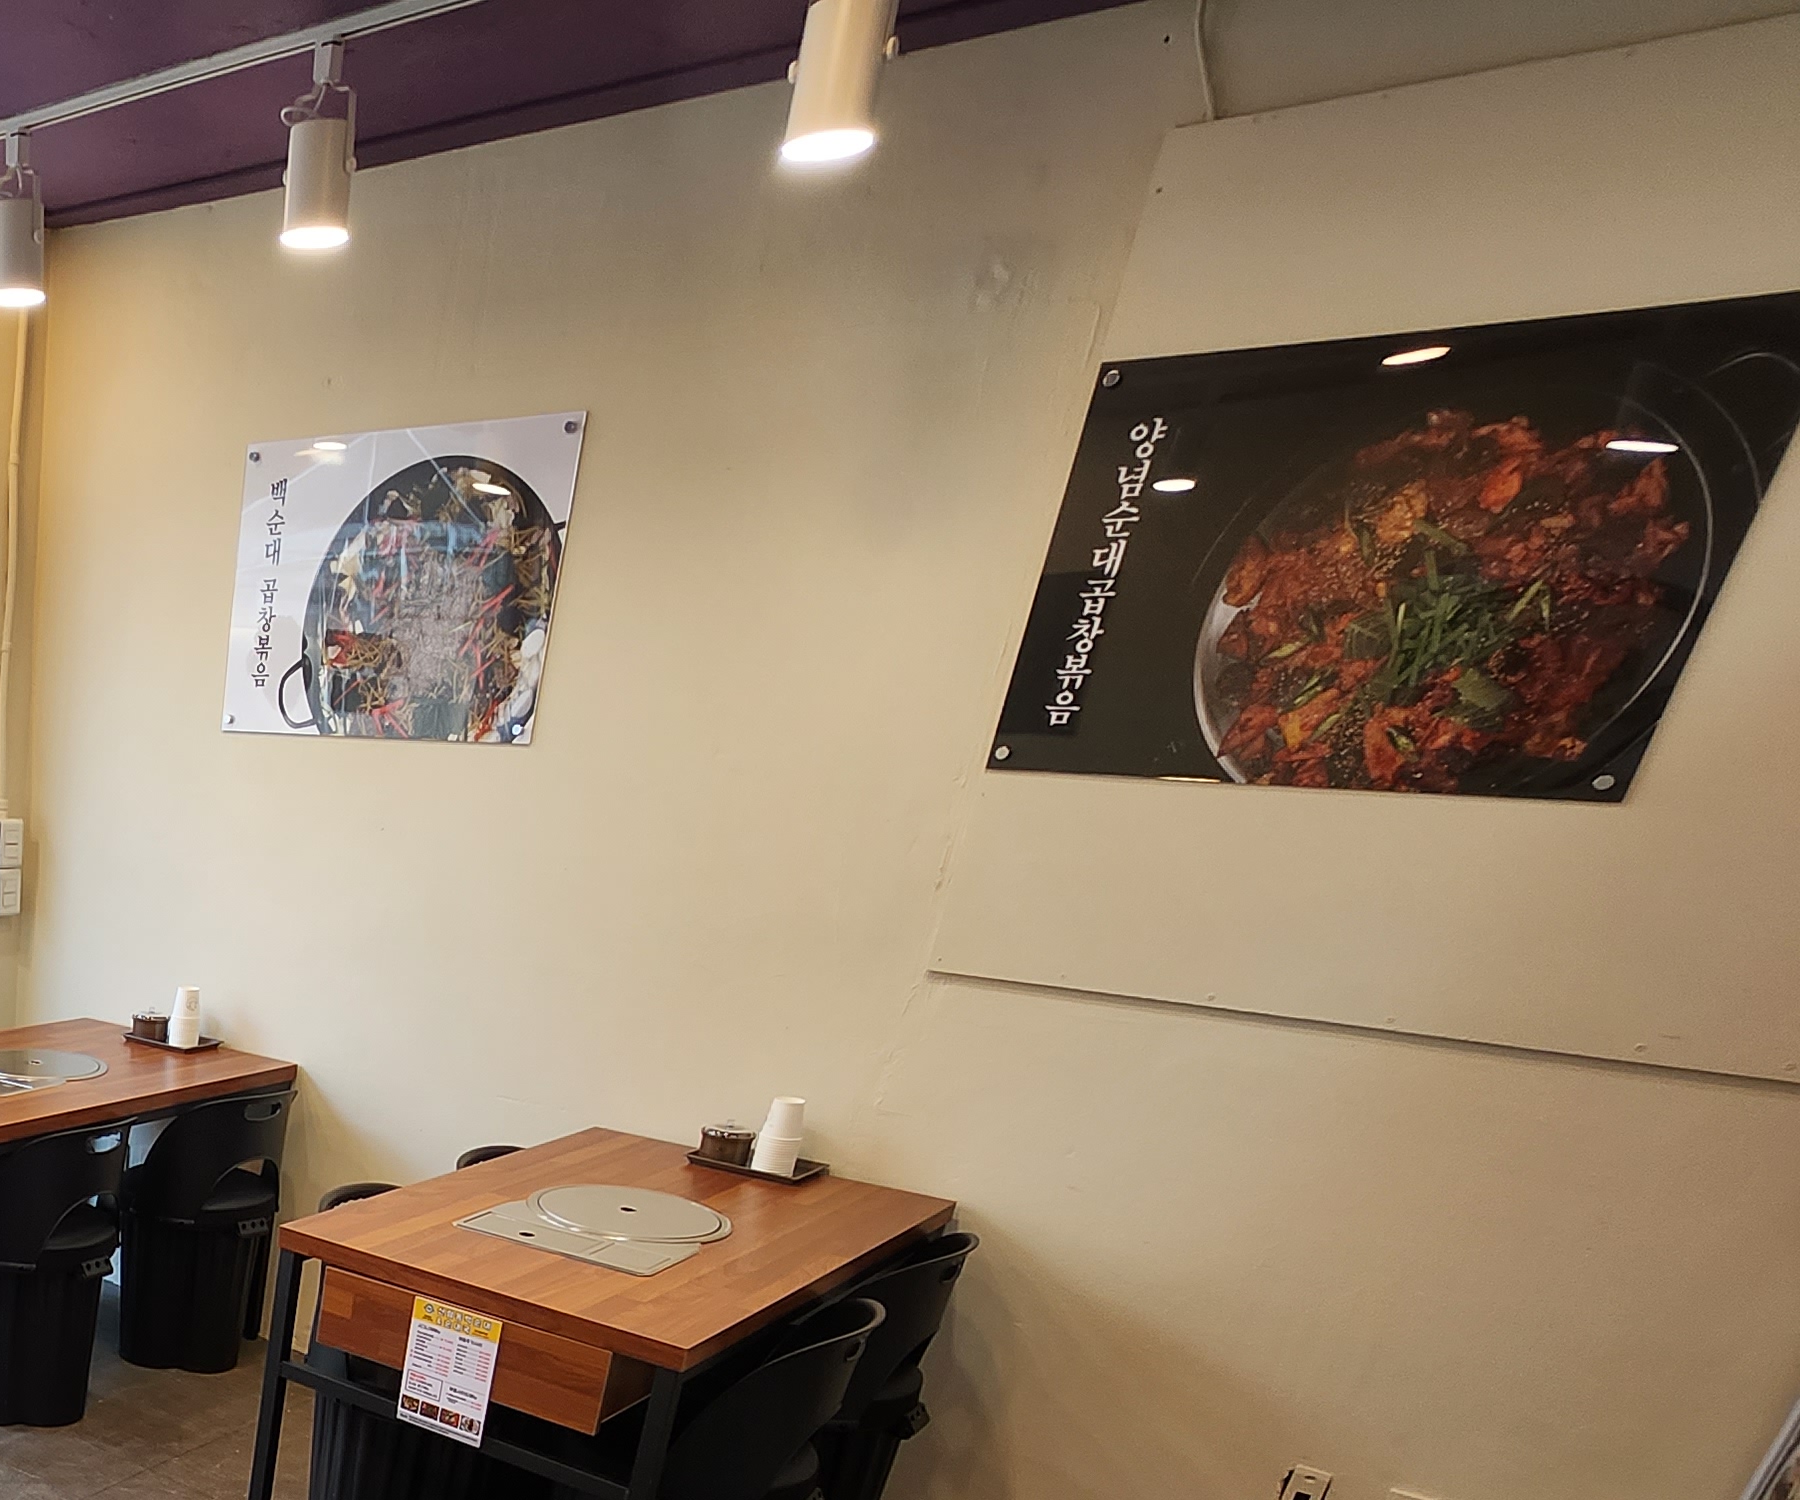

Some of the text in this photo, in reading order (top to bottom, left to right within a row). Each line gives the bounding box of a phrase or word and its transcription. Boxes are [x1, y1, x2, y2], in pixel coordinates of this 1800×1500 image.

[251, 478, 288, 687] 백순대 곱창볶음
[1045, 418, 1168, 726] 양념순대곱창볶음
